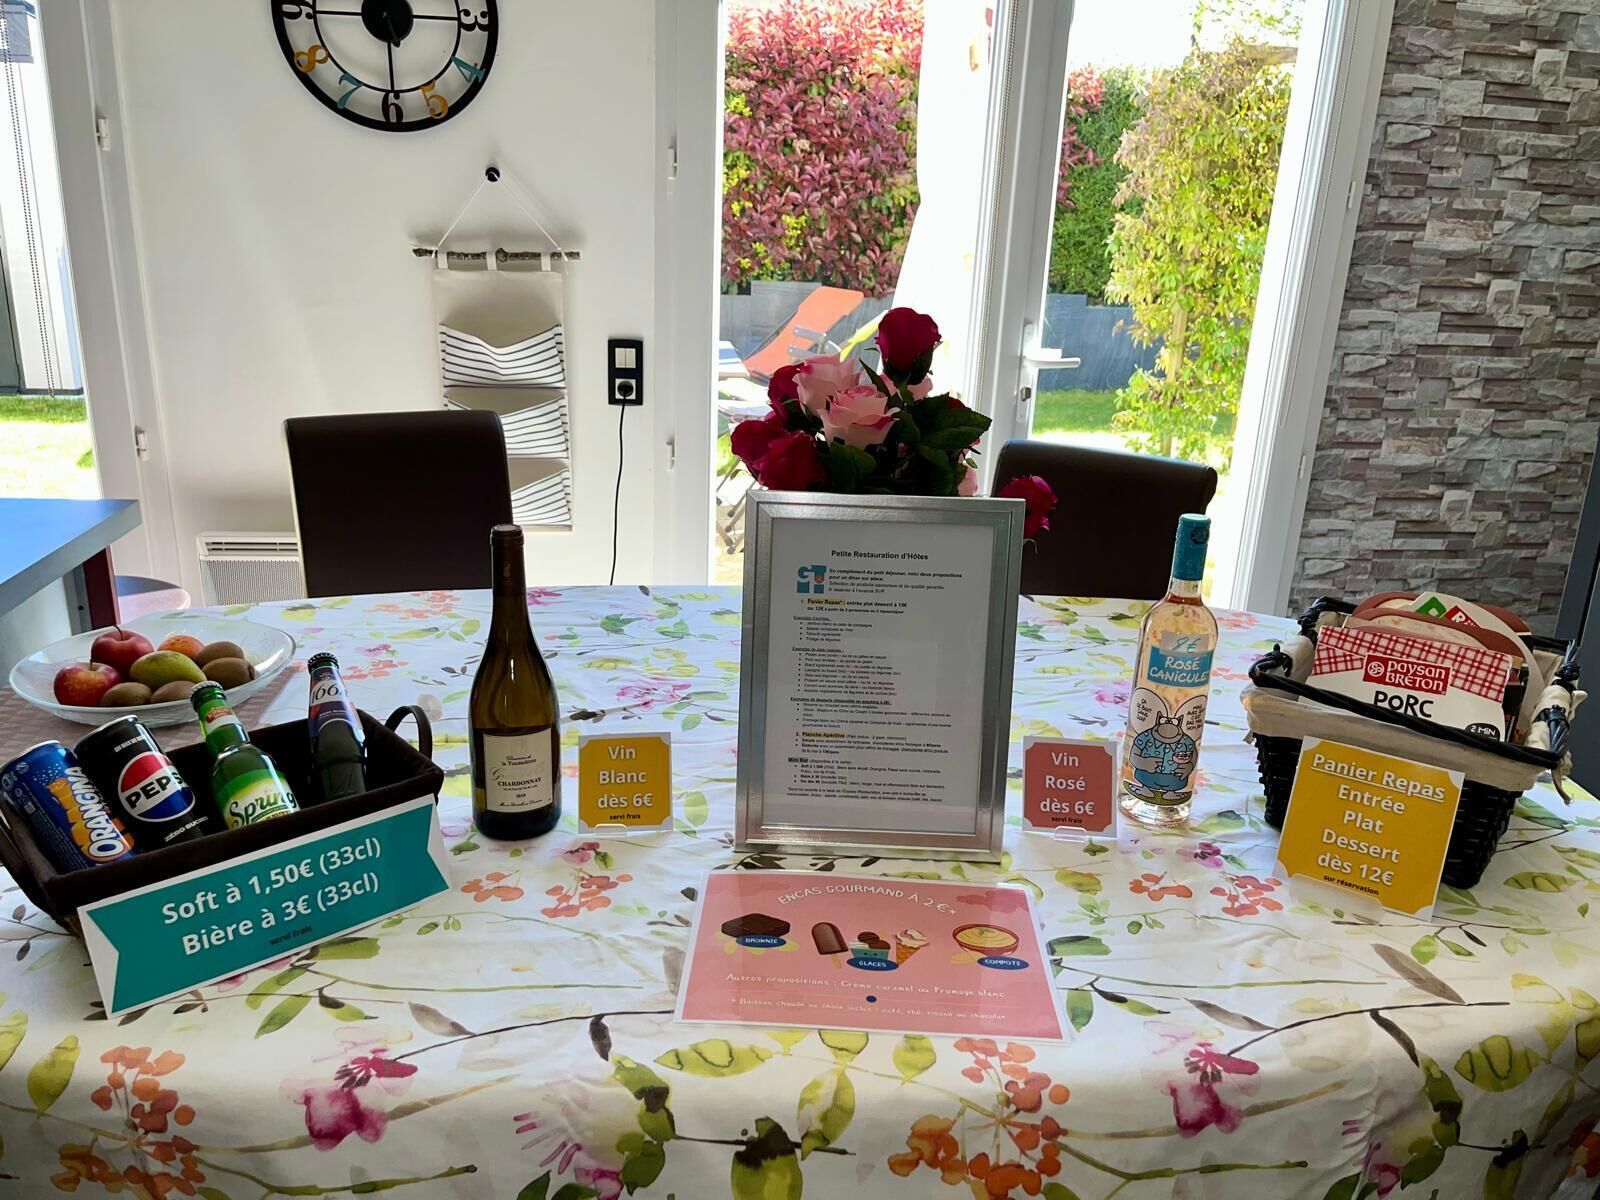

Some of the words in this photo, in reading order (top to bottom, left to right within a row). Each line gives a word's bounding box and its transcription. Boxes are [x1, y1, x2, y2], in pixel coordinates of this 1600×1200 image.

[459, 8, 489, 32] 3
[294, 44, 329, 73] 8
[451, 55, 486, 83] 4
[338, 72, 363, 109] 7
[419, 79, 448, 119] 5
[381, 91, 404, 123] 6
[853, 551, 899, 560] Restauration
[901, 552, 928, 560] d'Hôtes
[1165, 656, 1200, 671] ROSÉ
[1385, 672, 1443, 692] BRETON
[608, 745, 636, 760] Vin
[1050, 752, 1079, 767] Vin
[497, 776, 542, 788] CHARDONNAY
[599, 771, 647, 785] Blanc
[1045, 775, 1086, 791] Rosé
[1312, 753, 1377, 786] Panier
[1382, 771, 1446, 803] Repas
[597, 794, 627, 809] dès
[632, 792, 654, 808] 6€
[1040, 798, 1070, 814] dès
[1074, 801, 1095, 816] 6€
[1338, 784, 1406, 815] Entrée
[64, 766, 124, 858] ORANGINA
[626, 812, 641, 820] frais
[1343, 810, 1384, 834] Plat
[1322, 829, 1401, 863] Dessert
[162, 893, 218, 925] Soft
[226, 882, 242, 906] à
[248, 858, 315, 899] 1,50€
[319, 836, 382, 877] (33cl)
[1317, 852, 1352, 874] dès
[1360, 863, 1395, 887] 12€
[778, 886, 822, 906] ENCAS
[826, 885, 904, 898] GOURMAND
[923, 898, 934, 908] 2
[1324, 875, 1335, 883] sur
[1336, 878, 1380, 896] réservation
[182, 919, 254, 957] Bière
[261, 907, 277, 930] à
[282, 894, 312, 924] 3€
[317, 871, 381, 914] (33cl)
[858, 960, 887, 968] GLACES
[985, 958, 1021, 967] COMPOTE
[726, 974, 762, 983] Autres
[766, 977, 829, 986] propositions
[840, 980, 872, 989] Crème
[876, 985, 914, 993] caramel
[934, 986, 974, 997] Fromage
[978, 990, 1006, 998] blanc
